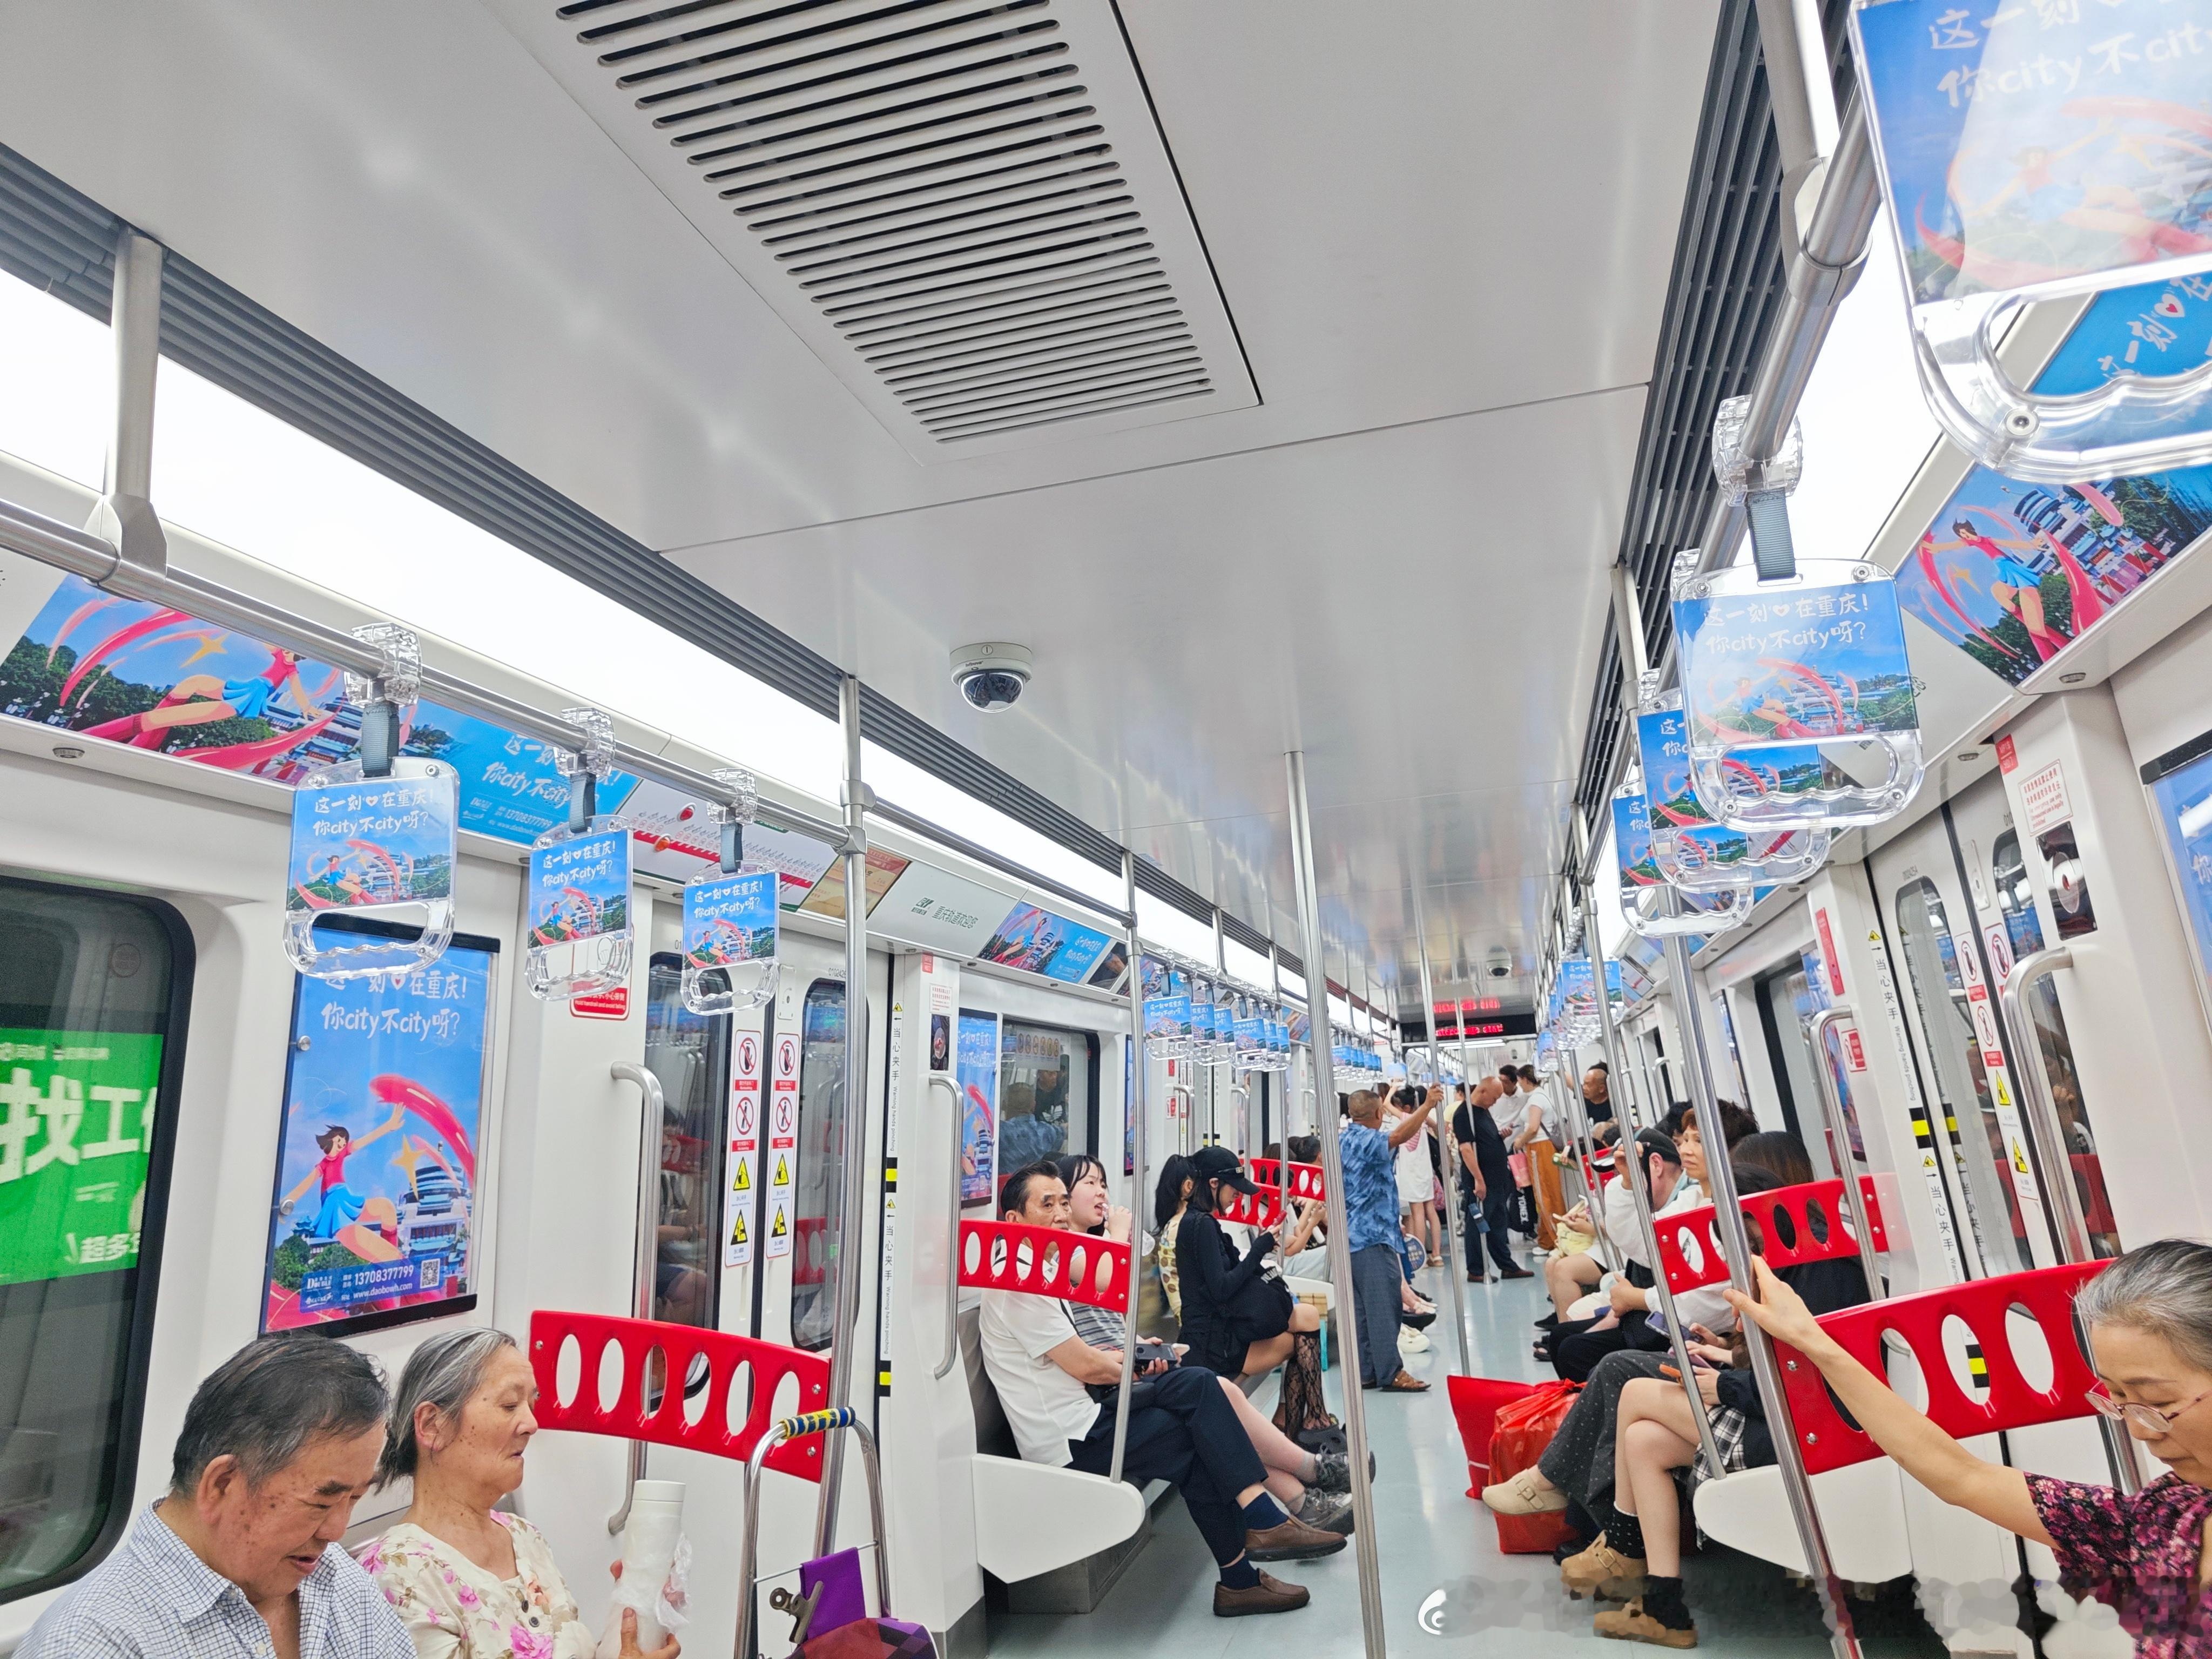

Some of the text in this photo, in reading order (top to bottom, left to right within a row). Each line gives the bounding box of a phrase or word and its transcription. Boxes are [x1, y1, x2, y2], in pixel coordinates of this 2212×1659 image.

[1937, 21, 2212, 108] 你city不cit
[312, 811, 429, 837] 你city不city呀?
[542, 859, 613, 887] 你city不city呀?
[694, 897, 761, 919] 你city不city呀?
[321, 1001, 460, 1041] 你city不city呀?
[1876, 958, 1899, 1020] 当心夹手
[1894, 1026, 1904, 1053] Warning
[1905, 1074, 1916, 1102] pinching
[891, 1028, 901, 1081] 当心夹手
[1931, 1185, 1954, 1251] 当心夹手
[885, 1225, 894, 1280] 当心夹手
[353, 1283, 413, 1299] www.daobowh.com
[355, 1265, 414, 1286] 13708377799
